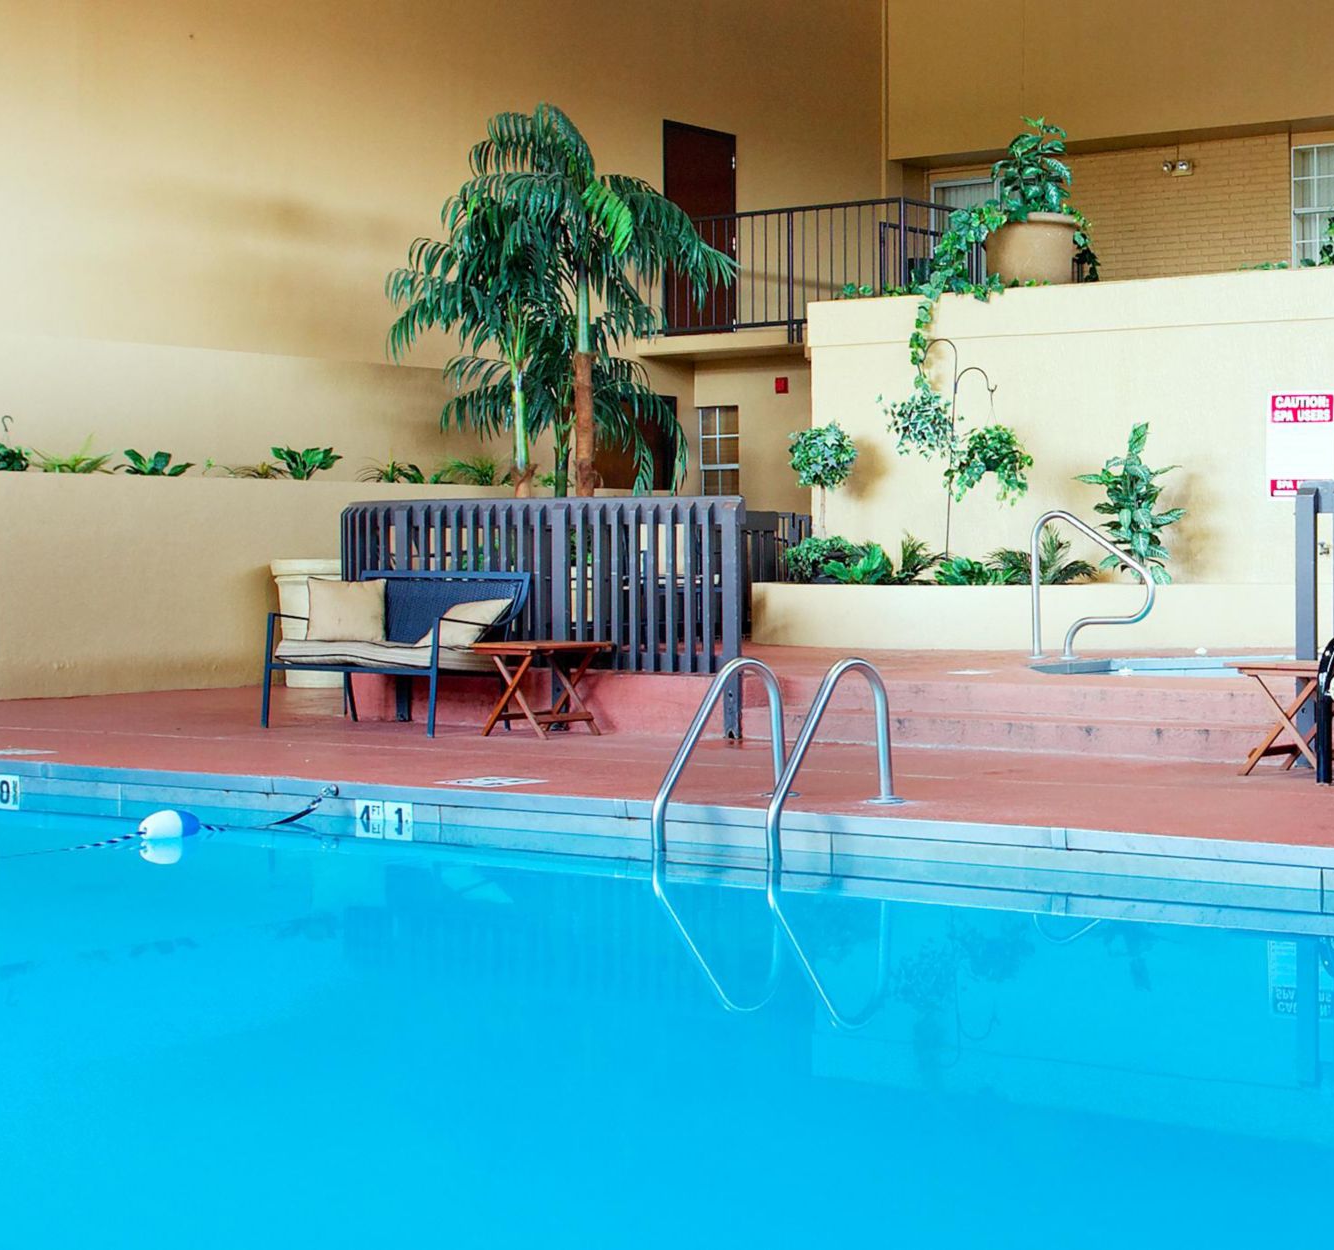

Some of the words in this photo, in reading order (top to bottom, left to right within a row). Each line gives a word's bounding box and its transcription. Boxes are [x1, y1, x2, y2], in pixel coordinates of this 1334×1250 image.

[1275, 395, 1330, 409] CAUTION:
[1274, 409, 1294, 421] SPA
[1297, 409, 1331, 421] USERS
